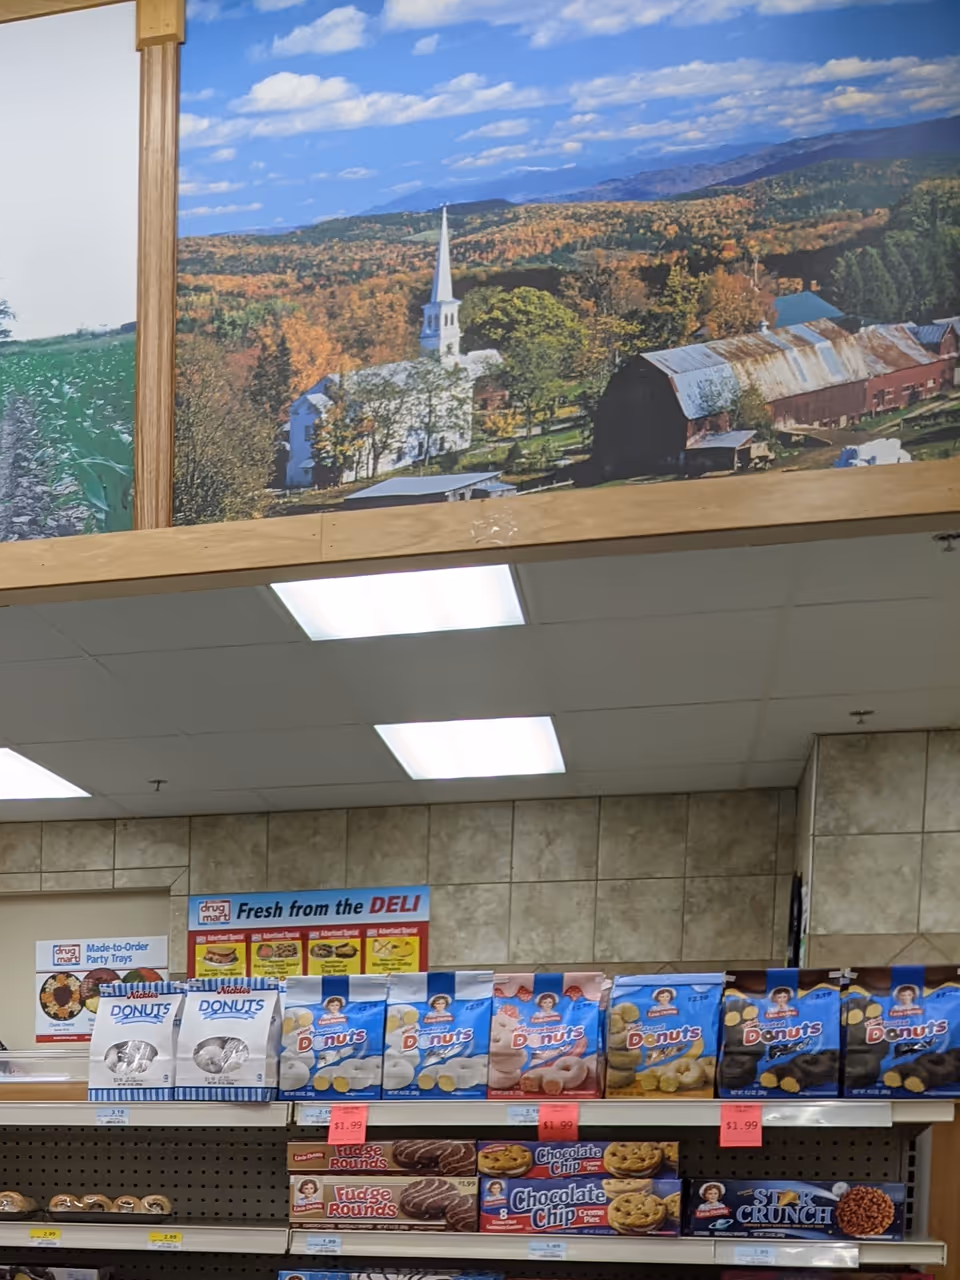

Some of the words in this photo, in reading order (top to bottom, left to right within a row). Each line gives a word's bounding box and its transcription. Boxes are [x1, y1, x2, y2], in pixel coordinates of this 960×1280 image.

[201, 901, 225, 915] drug
[236, 902, 283, 920] Fresh
[288, 900, 329, 917] from
[335, 898, 364, 916] the
[369, 895, 421, 914] DELI
[202, 914, 230, 922] mart
[55, 945, 75, 956] drug
[86, 942, 149, 952] Made-to-Order
[86, 955, 108, 965] Party
[111, 954, 132, 964] Trays
[216, 984, 251, 995] Nickles
[110, 1003, 171, 1016] DONUTS
[198, 999, 265, 1014] DONUTS
[402, 1027, 474, 1050] Donuts
[512, 1025, 585, 1049] Donuts
[627, 1025, 702, 1049] Donuts
[743, 1021, 823, 1045] Donuts
[866, 1019, 948, 1044] Donuts
[297, 1029, 367, 1052] Donuts
[334, 1121, 362, 1130] $1.99
[725, 1120, 758, 1131] $1.99
[535, 1144, 602, 1164] Chocolate
[330, 1158, 389, 1170] Rounds
[335, 1185, 392, 1203] Fudge
[511, 1184, 607, 1211] Chocolate
[327, 1203, 399, 1218] Rounds
[500, 1209, 507, 1219] 8
[531, 1205, 577, 1229] Chip
[736, 1205, 833, 1225] CRUNCH
